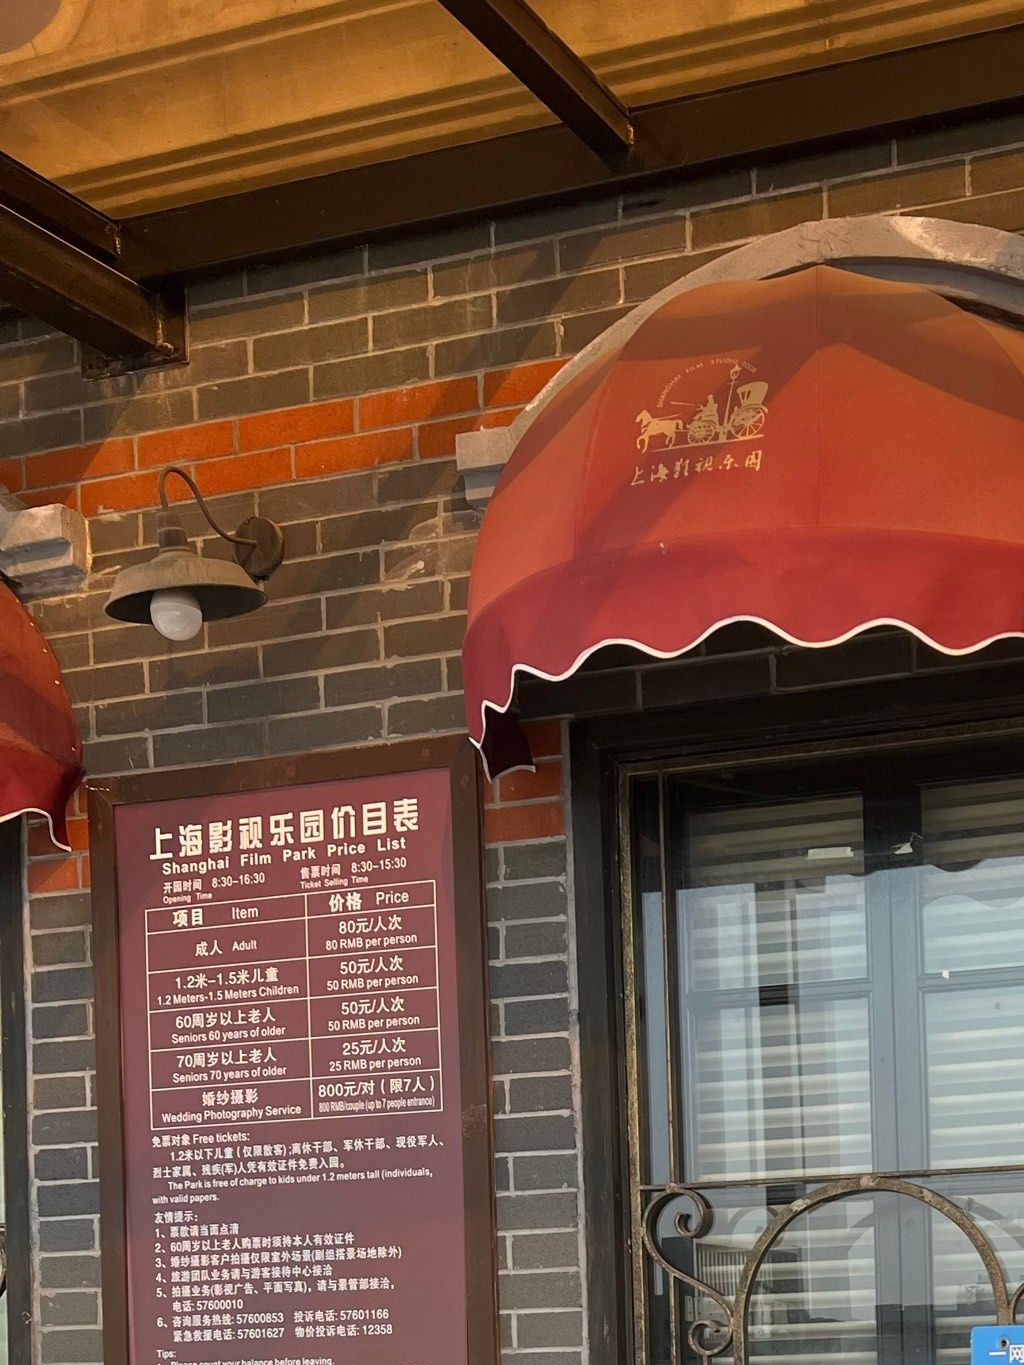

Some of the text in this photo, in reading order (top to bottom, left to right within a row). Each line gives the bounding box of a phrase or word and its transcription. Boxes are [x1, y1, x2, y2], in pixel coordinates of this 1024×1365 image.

[150, 799, 418, 860] 上海影视乐园价目表
[163, 837, 406, 875] Shanghai Film Park Price List
[339, 915, 402, 934] 80元/人次
[196, 940, 257, 956] 成人 Adult
[343, 1037, 406, 1055] 25元/人次
[177, 1047, 277, 1068] 70周岁以上老人
[330, 1057, 421, 1071] 25 RMB per person
[173, 1066, 287, 1083] Seniors 70 years of older
[157, 1350, 176, 1359] Tips:
